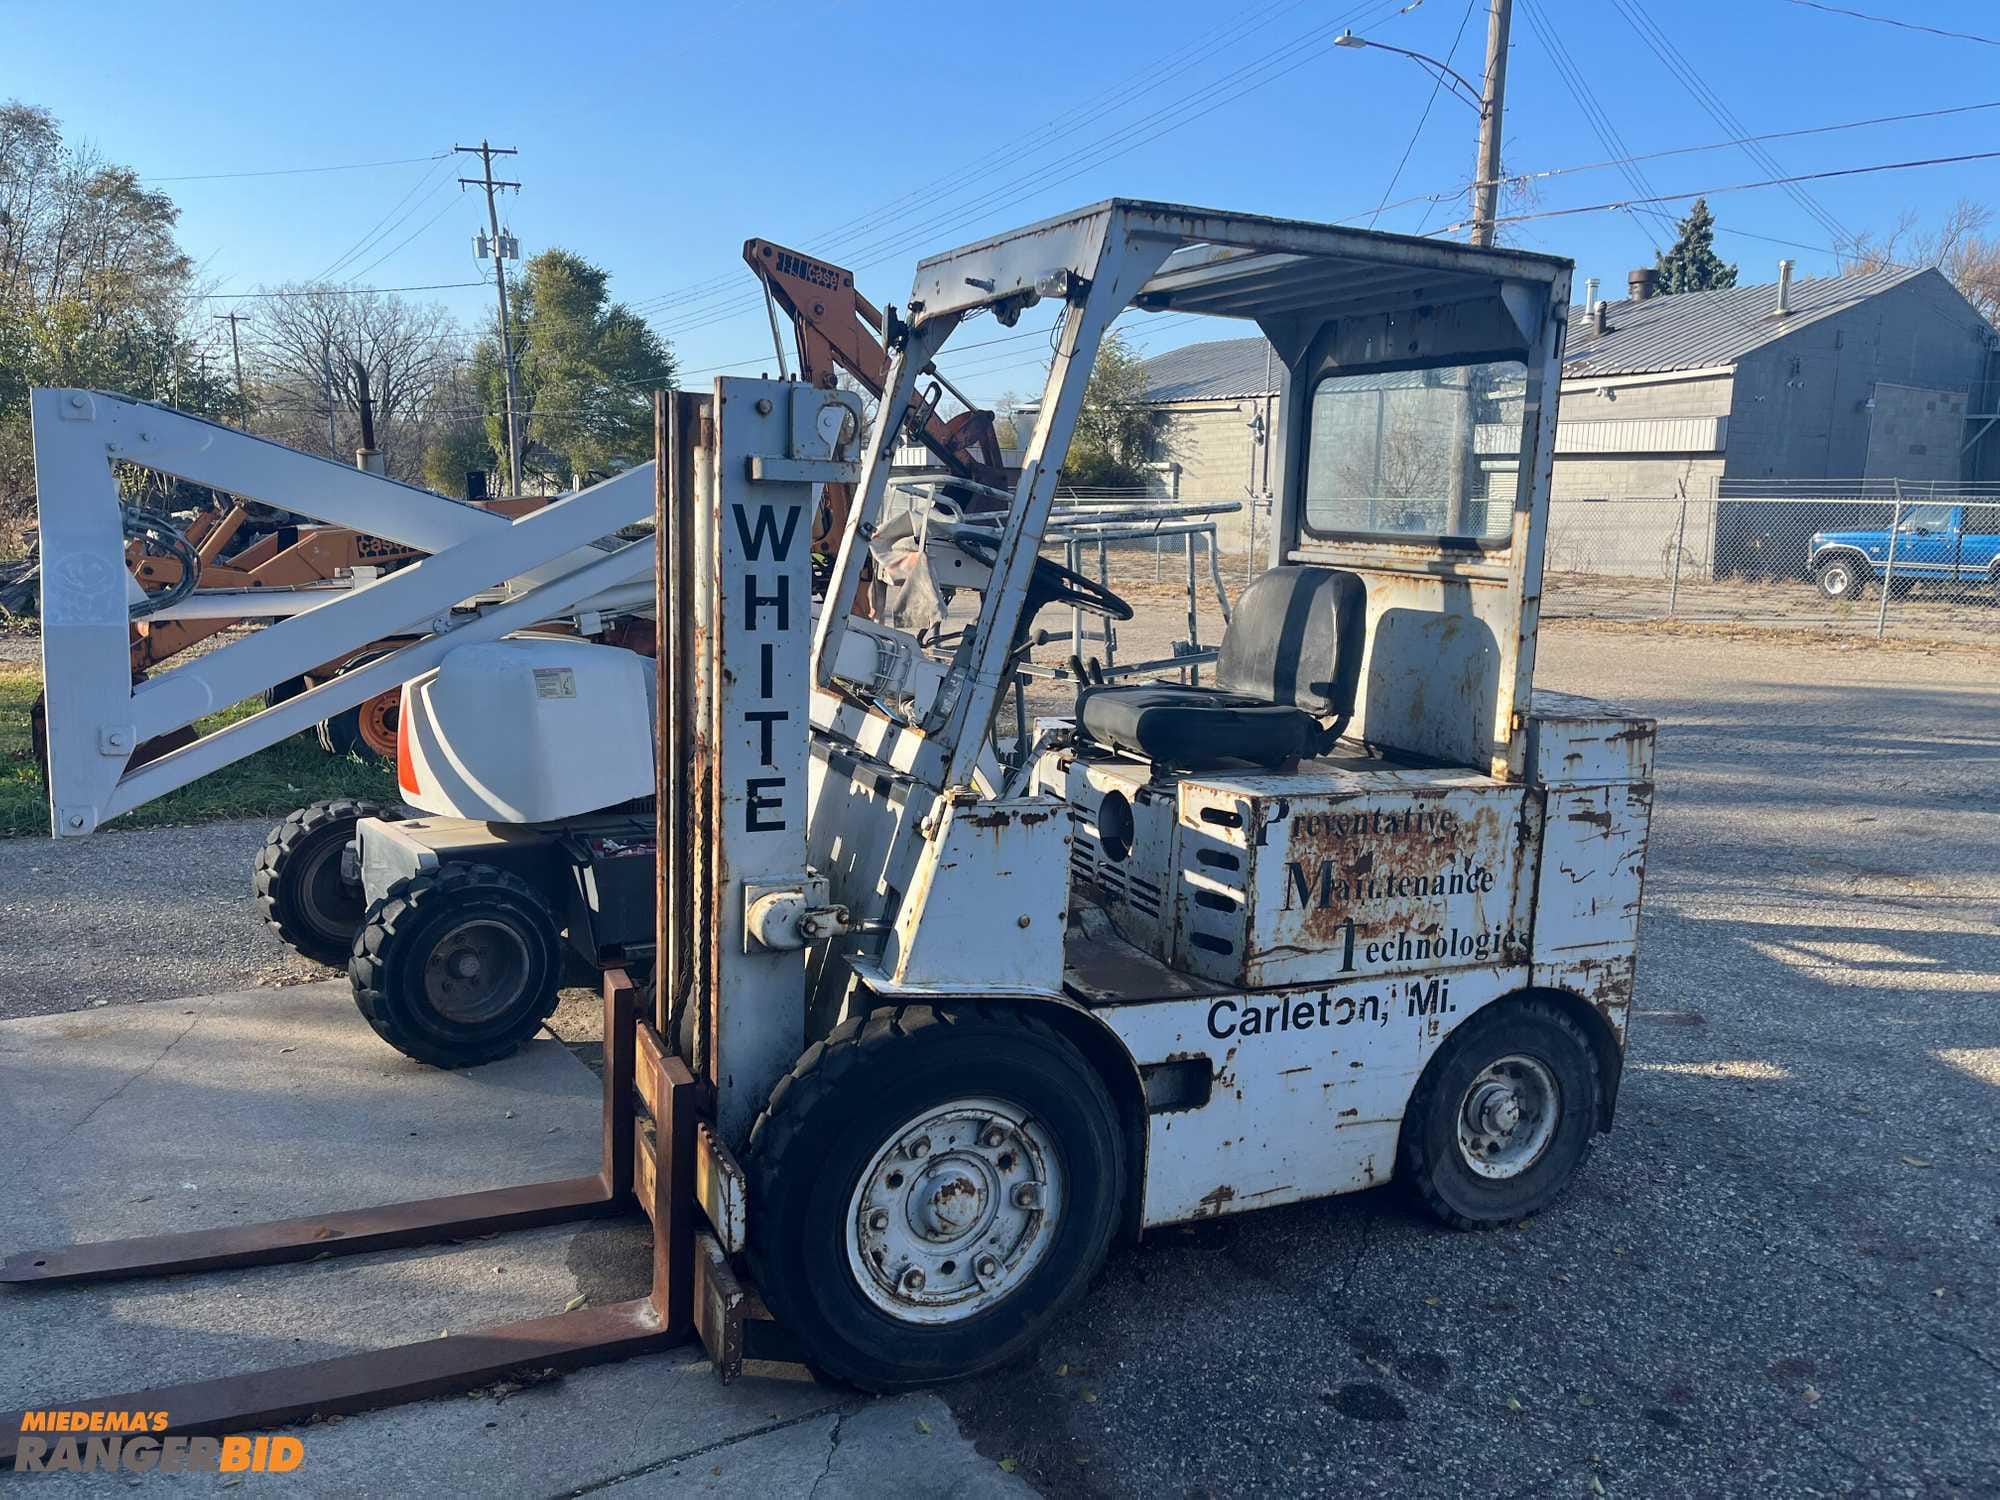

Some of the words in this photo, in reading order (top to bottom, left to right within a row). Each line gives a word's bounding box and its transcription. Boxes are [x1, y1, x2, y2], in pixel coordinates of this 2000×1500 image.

[731, 503, 802, 832] WHITE
[1207, 992, 1389, 1040] Carleton,
[1408, 979, 1457, 1017] Mi.
